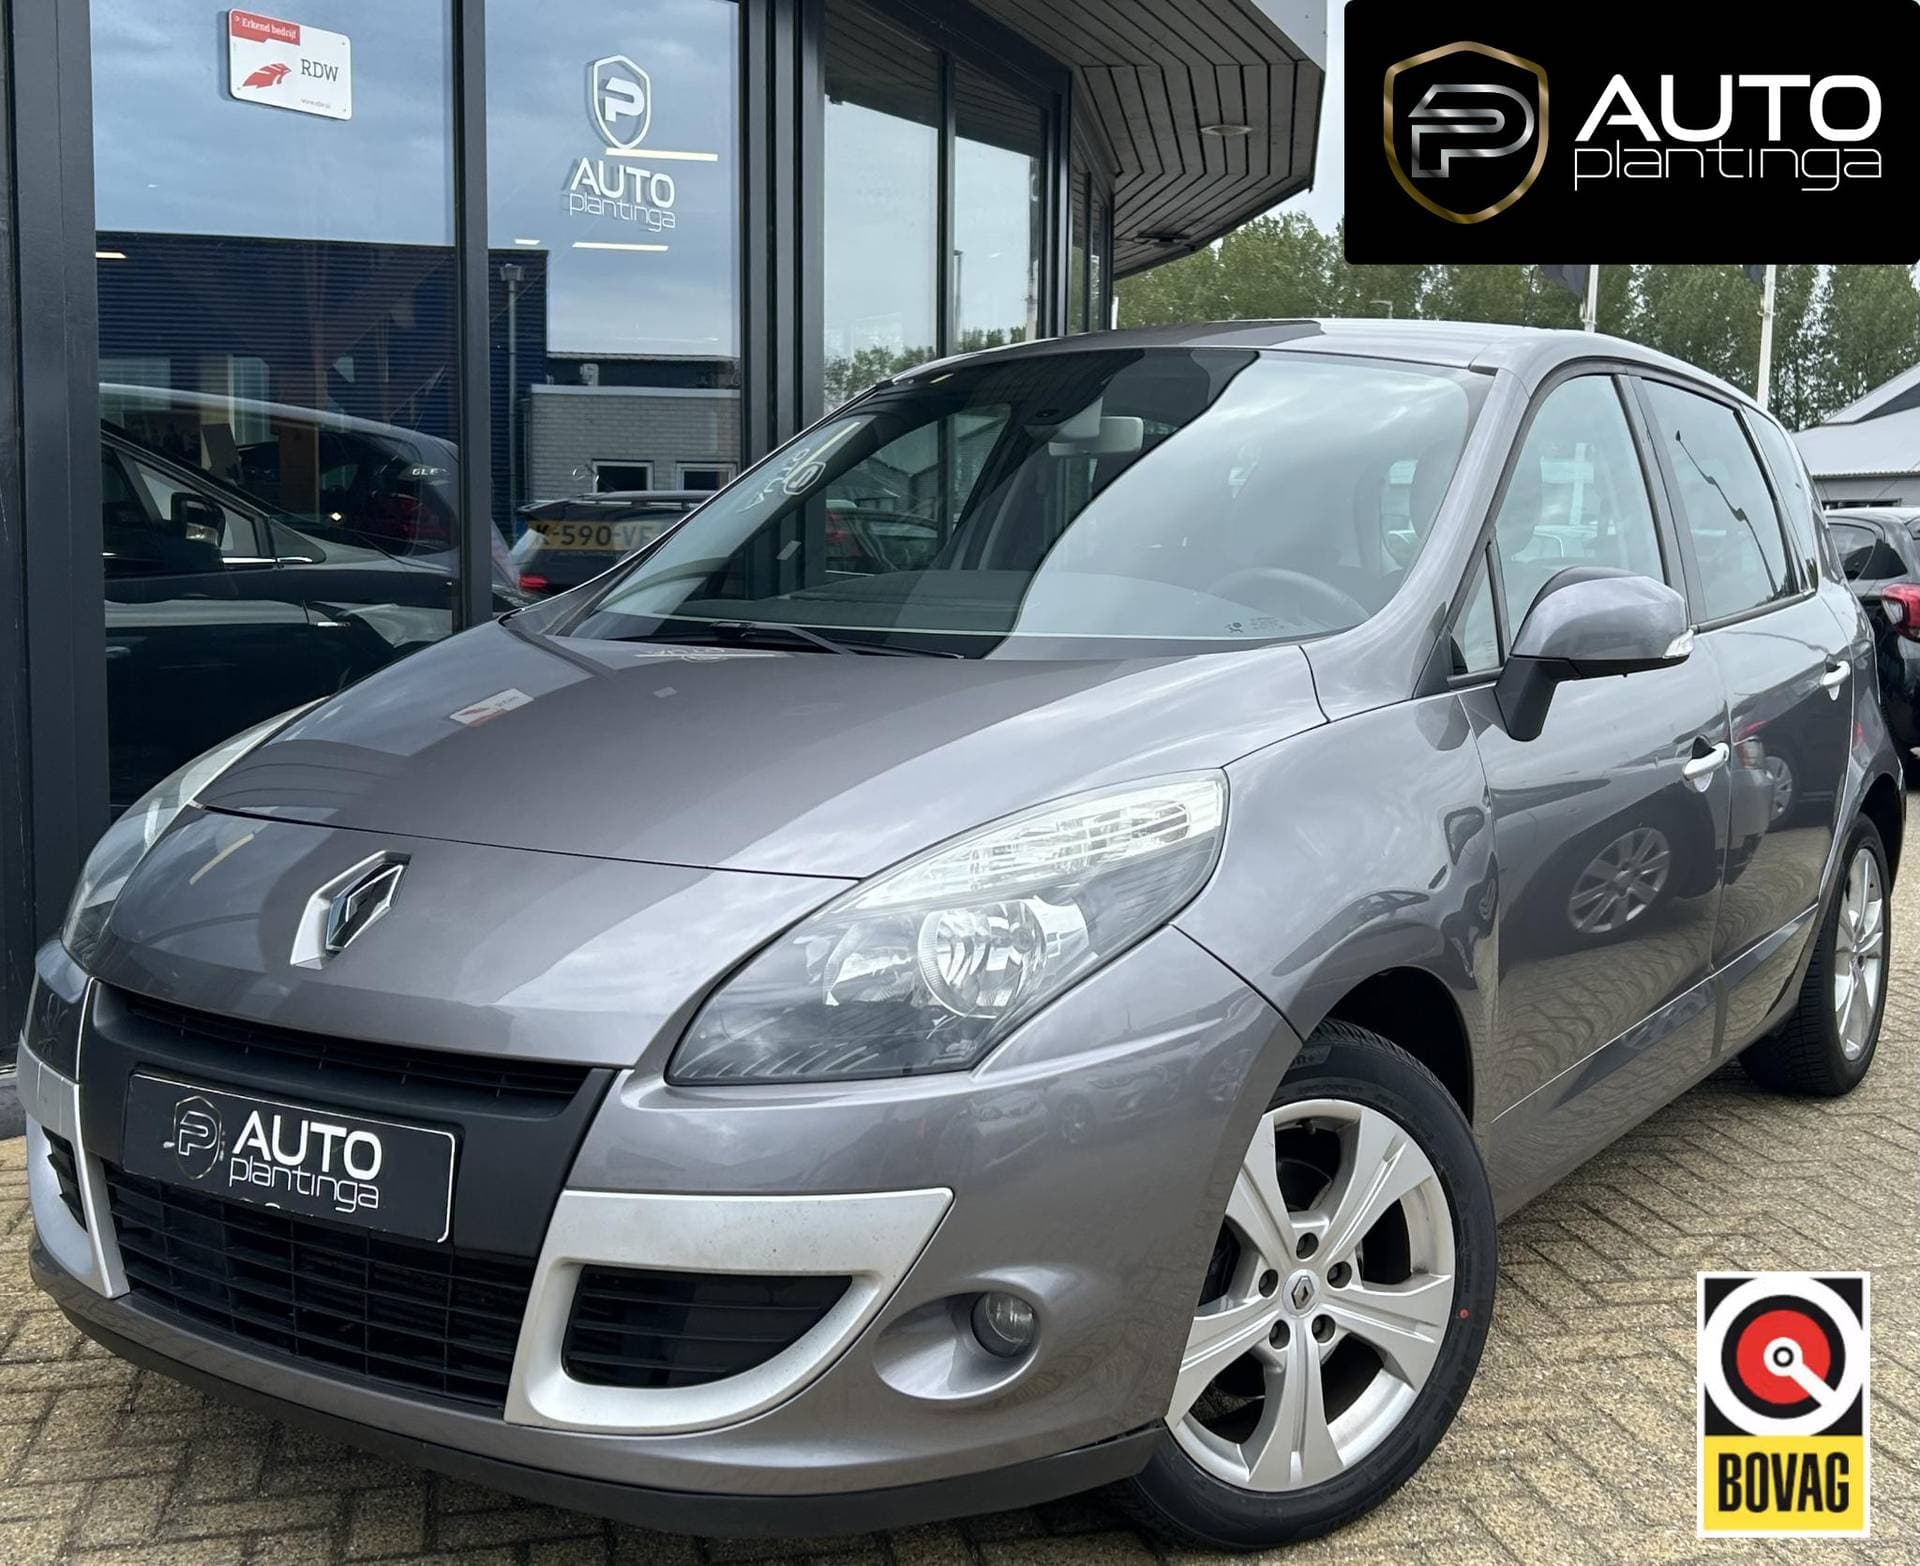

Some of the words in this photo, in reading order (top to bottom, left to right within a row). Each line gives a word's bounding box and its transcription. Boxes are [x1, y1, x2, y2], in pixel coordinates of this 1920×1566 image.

[242, 17, 270, 33] Erkend
[271, 23, 297, 39] bedrijf
[300, 58, 339, 82] RDW
[570, 157, 675, 209] AUTO
[569, 192, 676, 233] plantinga
[232, 1110, 383, 1181] AUTO
[229, 1156, 380, 1213] plantinga
